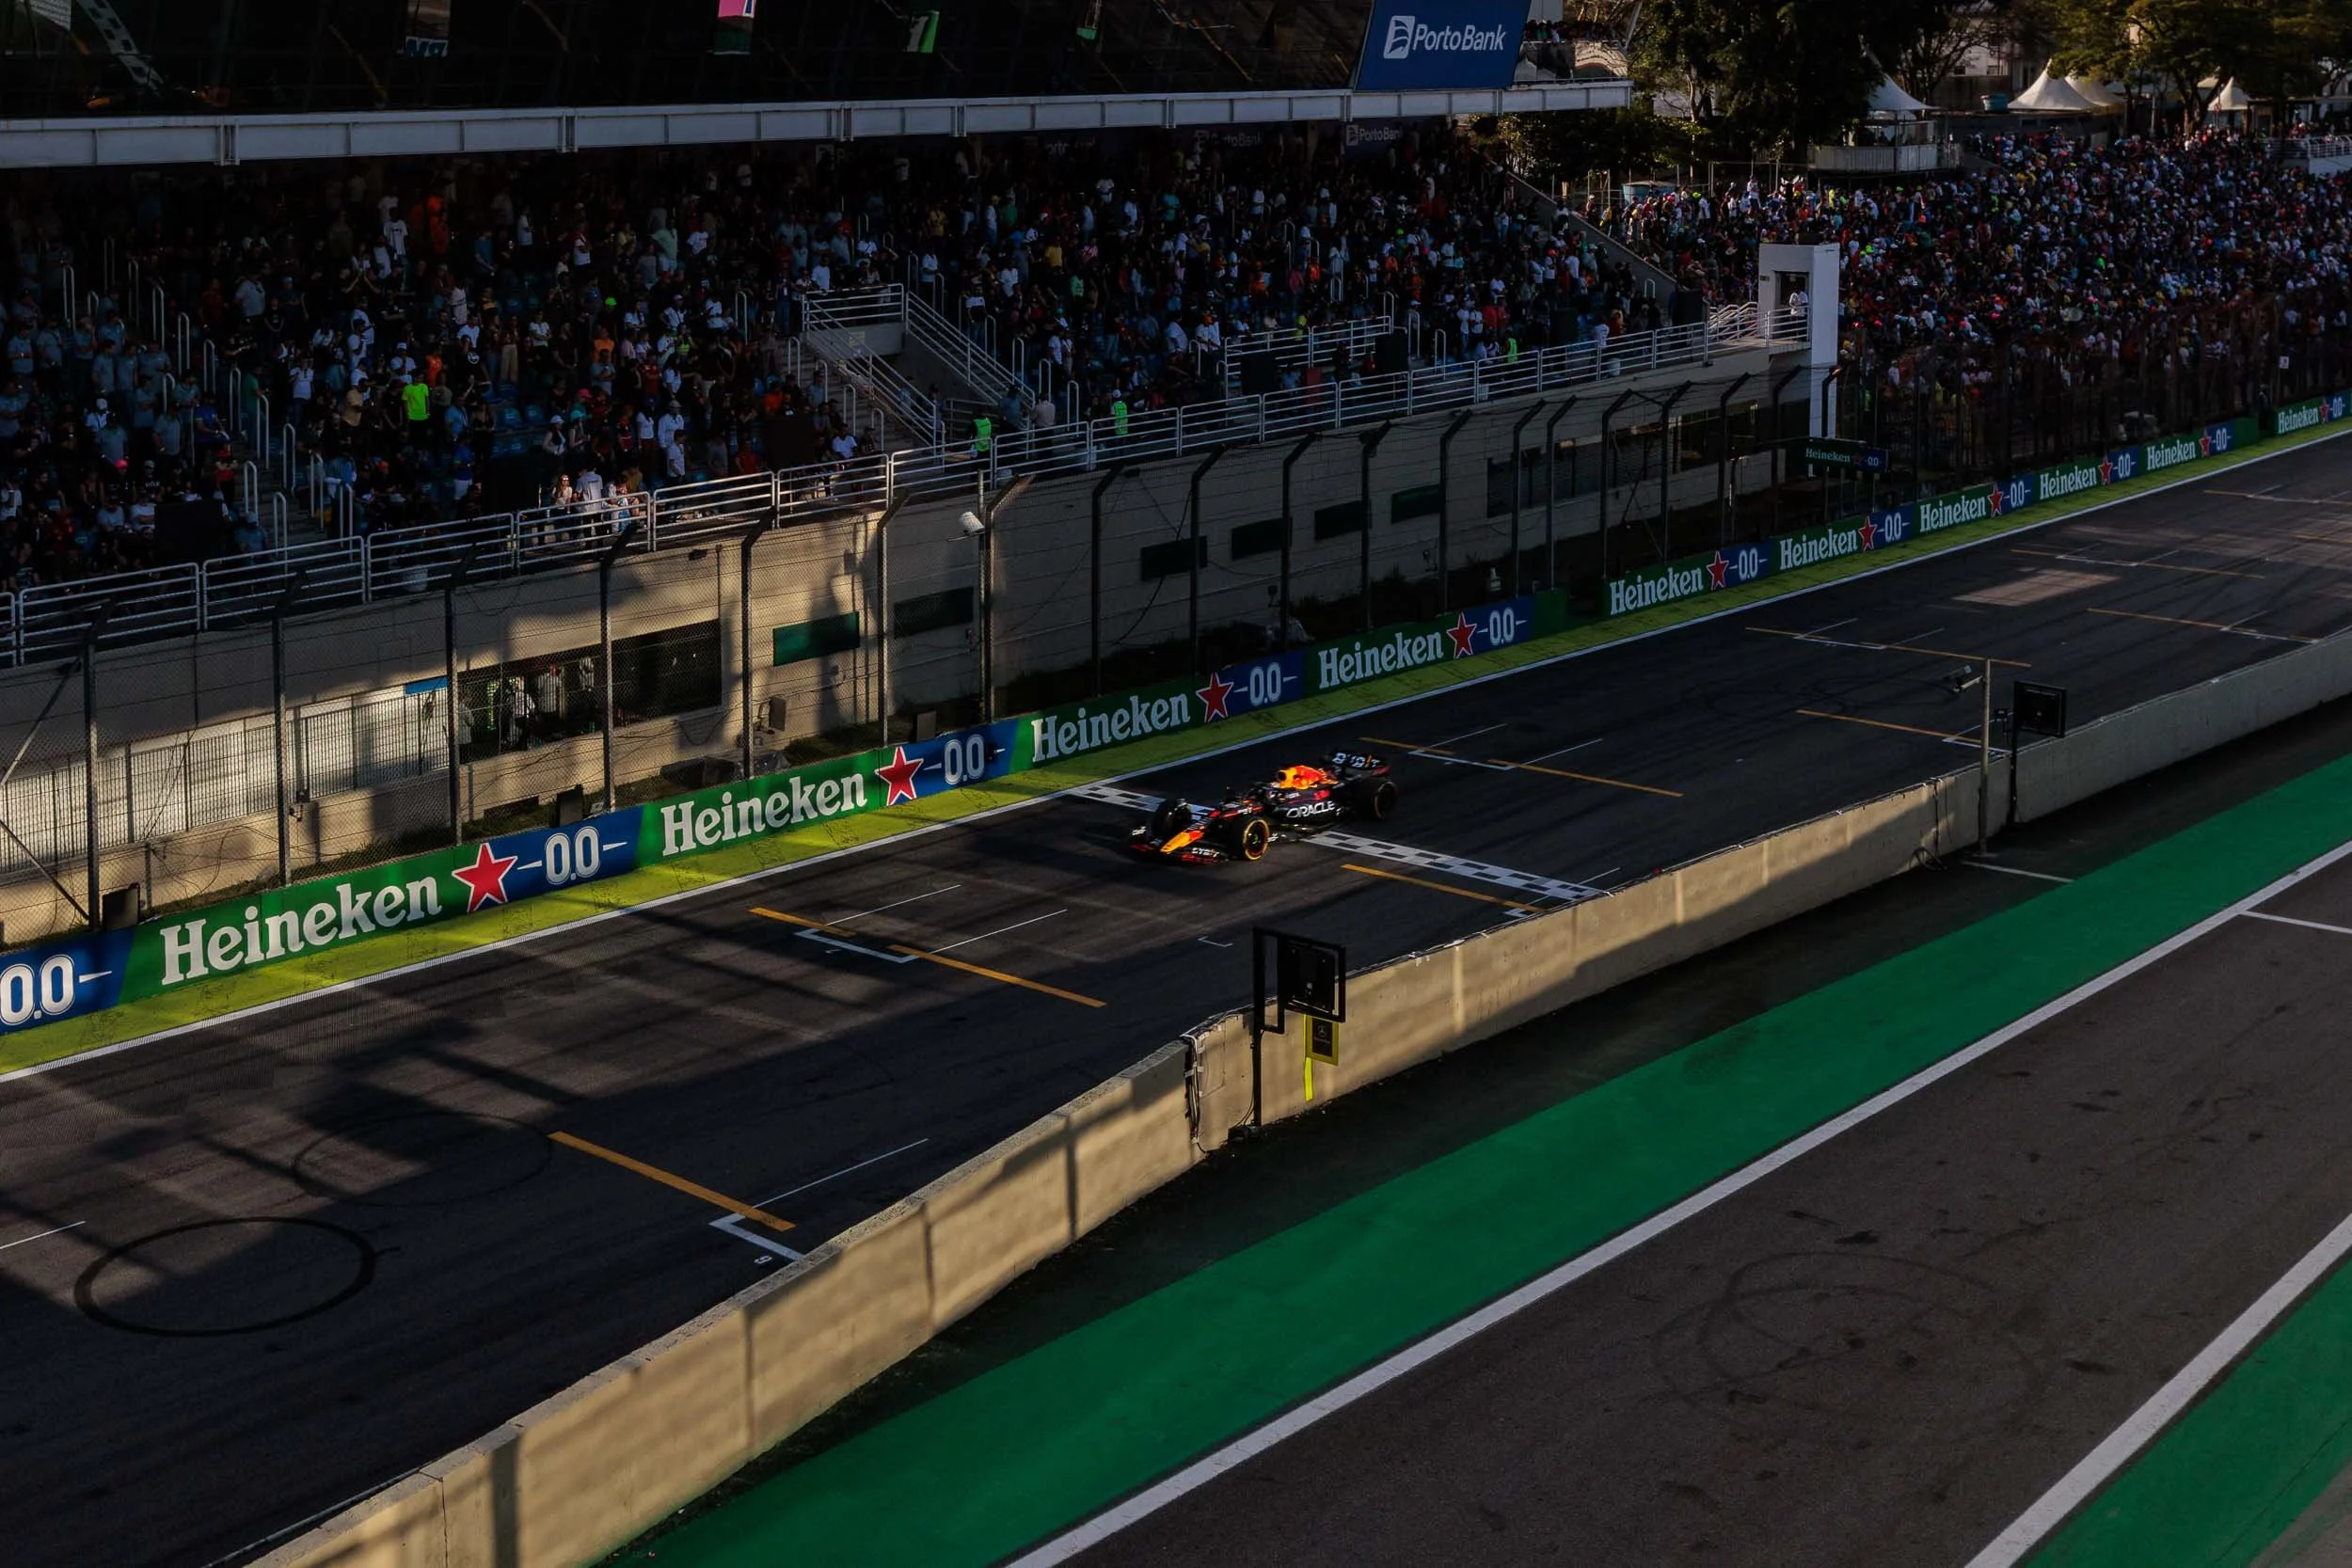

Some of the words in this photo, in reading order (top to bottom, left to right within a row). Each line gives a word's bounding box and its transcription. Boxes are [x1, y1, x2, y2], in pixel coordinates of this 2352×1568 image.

[2278, 405, 2320, 435] Heineken
[1806, 448, 1851, 464] Heineken
[2147, 438, 2196, 470] Heineken
[2040, 465, 2097, 499] Heineken
[1919, 495, 1986, 532] Heineken
[1779, 527, 1858, 570] Heineken
[1610, 566, 1703, 616] Heineken
[1318, 631, 1444, 689] Heineken
[1488, 607, 1515, 644] 0.0
[1031, 691, 1190, 762] Heineken
[1248, 662, 1281, 705] 0.0
[660, 770, 867, 857] Heineken
[944, 734, 985, 785] 0.0
[1286, 800, 1336, 818] ORACLE
[160, 877, 442, 985] Heineken
[544, 826, 600, 885] 0.0
